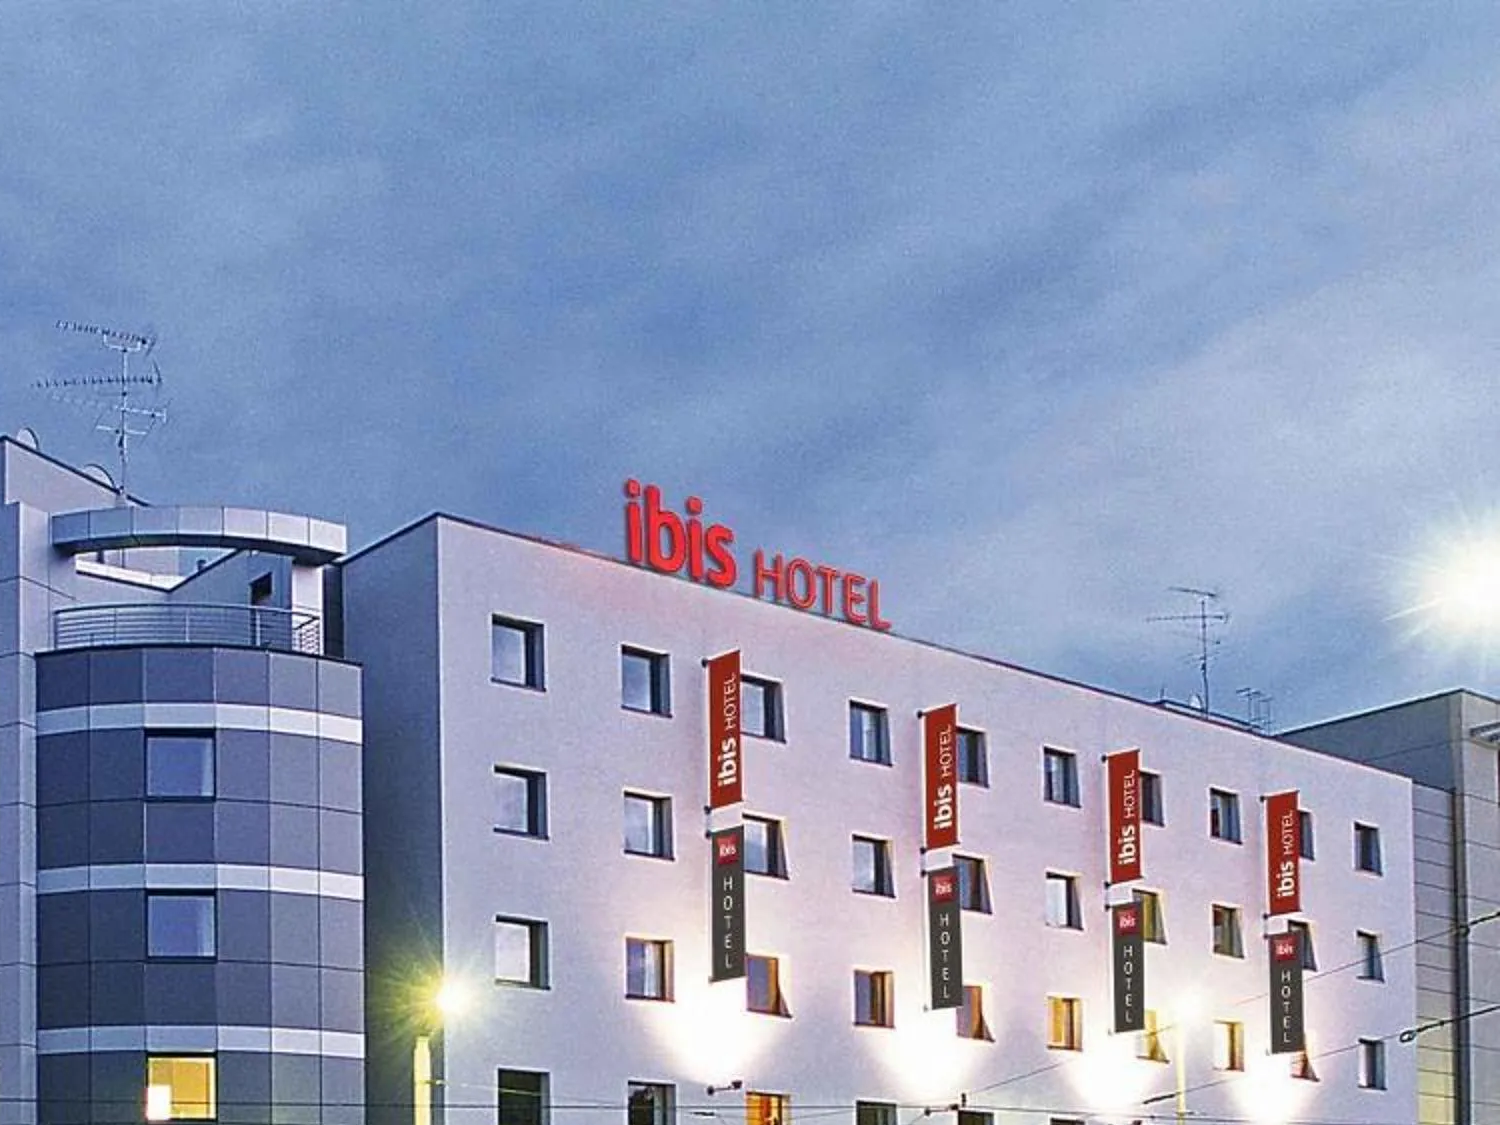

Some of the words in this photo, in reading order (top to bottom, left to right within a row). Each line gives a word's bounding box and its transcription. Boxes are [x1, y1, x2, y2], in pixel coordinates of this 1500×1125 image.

[625, 478, 737, 588] ibis
[754, 548, 892, 630] HOTEL
[723, 672, 737, 731] HOTEL
[717, 738, 738, 787] ibis
[939, 723, 953, 777] HOTEL
[933, 783, 953, 830] ibis
[1123, 769, 1135, 819] HOTEL
[1117, 824, 1136, 865] ibis
[1282, 810, 1294, 855] HOTEL
[1276, 860, 1295, 898] ibis
[723, 876, 733, 969] HOTEL
[940, 913, 950, 999] HOTEL
[1123, 945, 1133, 1023] HOTEL
[1281, 969, 1292, 1043] HOTEL
